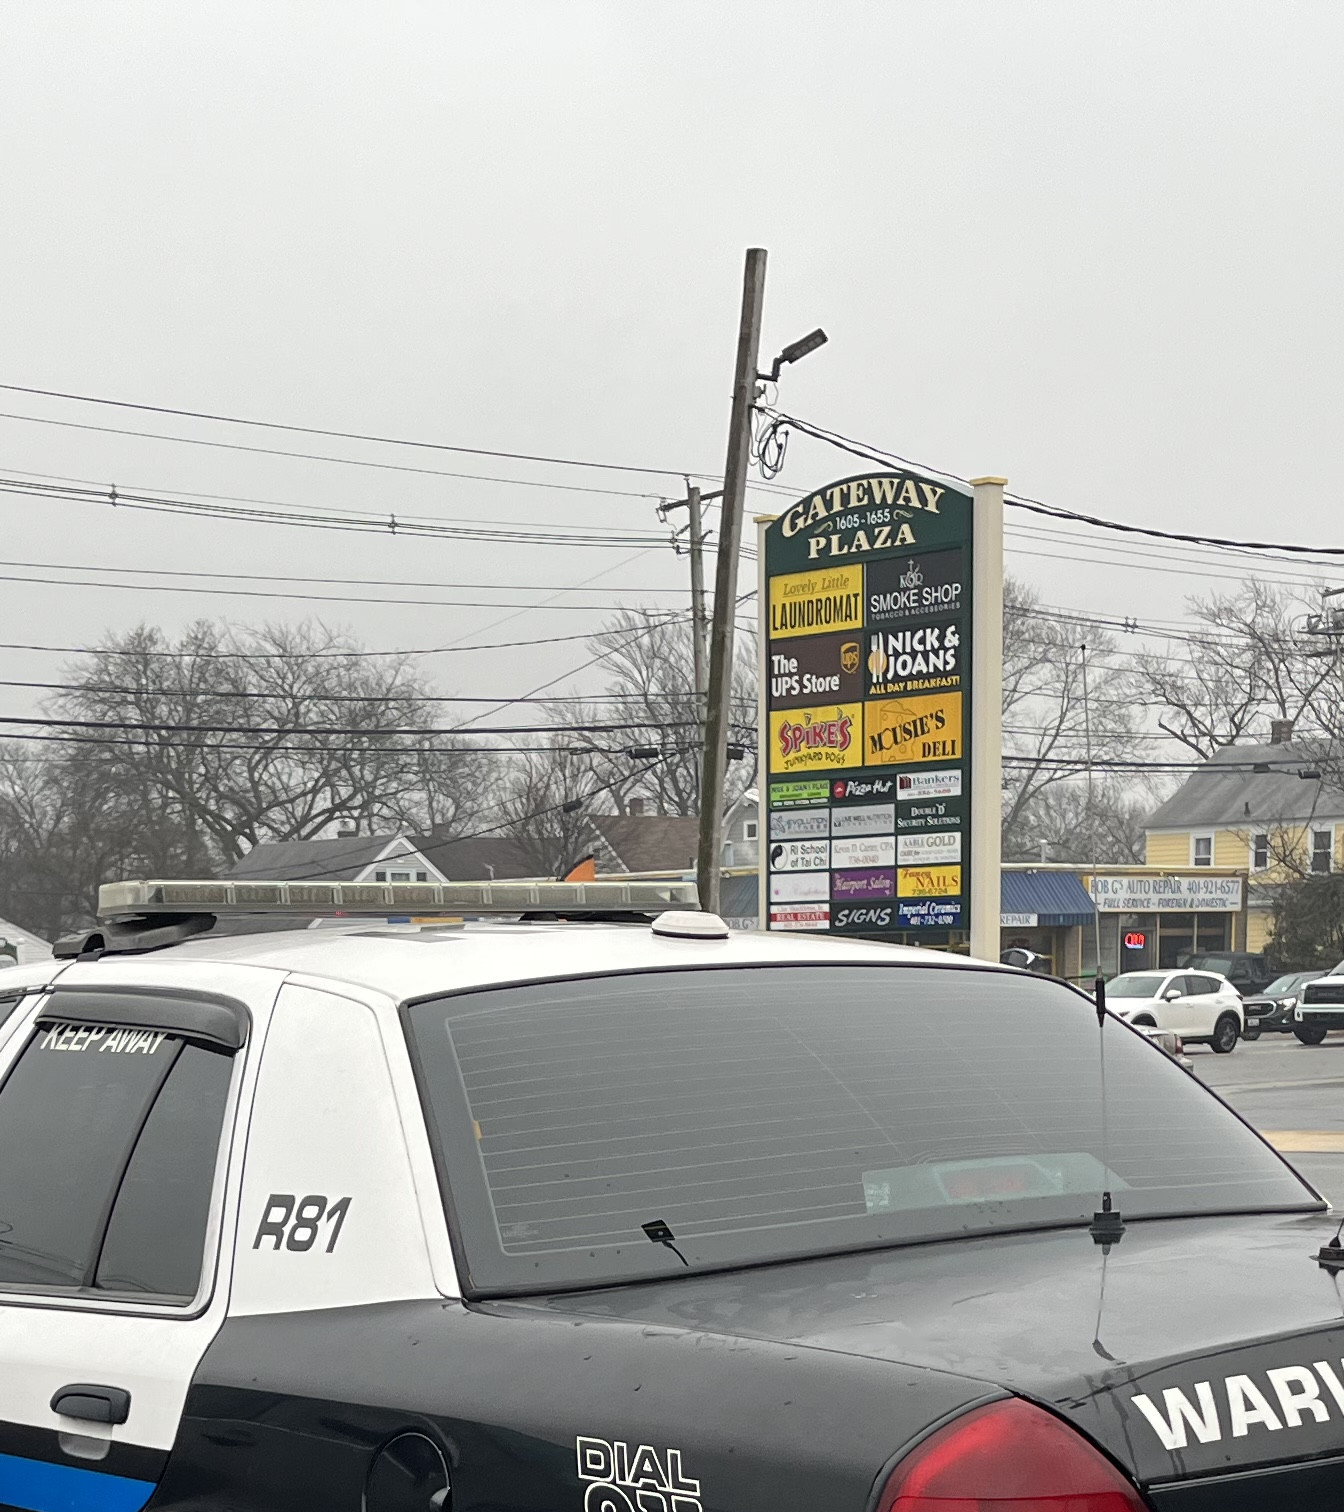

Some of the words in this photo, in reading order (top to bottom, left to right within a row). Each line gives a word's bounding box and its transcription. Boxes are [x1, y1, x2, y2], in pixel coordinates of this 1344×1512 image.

[782, 478, 945, 538] GATEWAY
[808, 524, 916, 559] PLAZA
[783, 579, 817, 596] Lovely
[821, 574, 849, 590] Little
[871, 589, 918, 612] SMOKE
[922, 583, 961, 605] SHOP
[772, 593, 859, 631] LAUNDROMAT
[871, 610, 903, 620] TOBACCO
[911, 602, 960, 615] ACCESSORIES
[887, 627, 940, 654] NICK
[944, 625, 960, 648] &
[771, 654, 798, 674] The
[843, 651, 859, 668] ups
[887, 648, 956, 680] JOANS
[771, 675, 800, 697] UPS
[802, 673, 839, 694] Store
[869, 684, 886, 694] ALL
[887, 682, 905, 692] DAY
[906, 676, 960, 690] BREAKFAST!
[869, 709, 946, 755] MOUSIE'S
[921, 739, 956, 758] DELI
[784, 752, 823, 770] JUNKYARD
[825, 751, 846, 766] DOGS
[845, 780, 872, 797] Pizza
[872, 779, 893, 794] Hut
[912, 774, 960, 786] Bankers
[911, 807, 936, 816] DOUBLE
[897, 818, 926, 828] SECURITY
[927, 816, 960, 826] SOLUTIONS
[790, 845, 798, 855] RI
[801, 843, 827, 855] School
[926, 835, 956, 848] GOLD
[790, 857, 798, 868] of
[801, 857, 811, 867] Tai
[814, 856, 826, 867] Chi
[916, 875, 959, 888] NAILS
[1126, 880, 1151, 894] AUTO
[1153, 879, 1182, 894] REPAIR
[1186, 879, 1241, 895] 401-921-6577
[899, 901, 930, 918] Imperial
[1103, 898, 1121, 909] FULL
[1122, 898, 1151, 909] SERVICE
[1195, 897, 1229, 908] DOMESTIC
[776, 913, 794, 922] REAL
[797, 912, 824, 921] ESTATE
[835, 908, 892, 927] SIGNS
[1001, 914, 1031, 925] REPAIR
[40, 1023, 108, 1051] KEEP
[99, 1028, 169, 1054] AWAY
[252, 1193, 353, 1254] R81
[576, 1435, 701, 1497] DIAL
